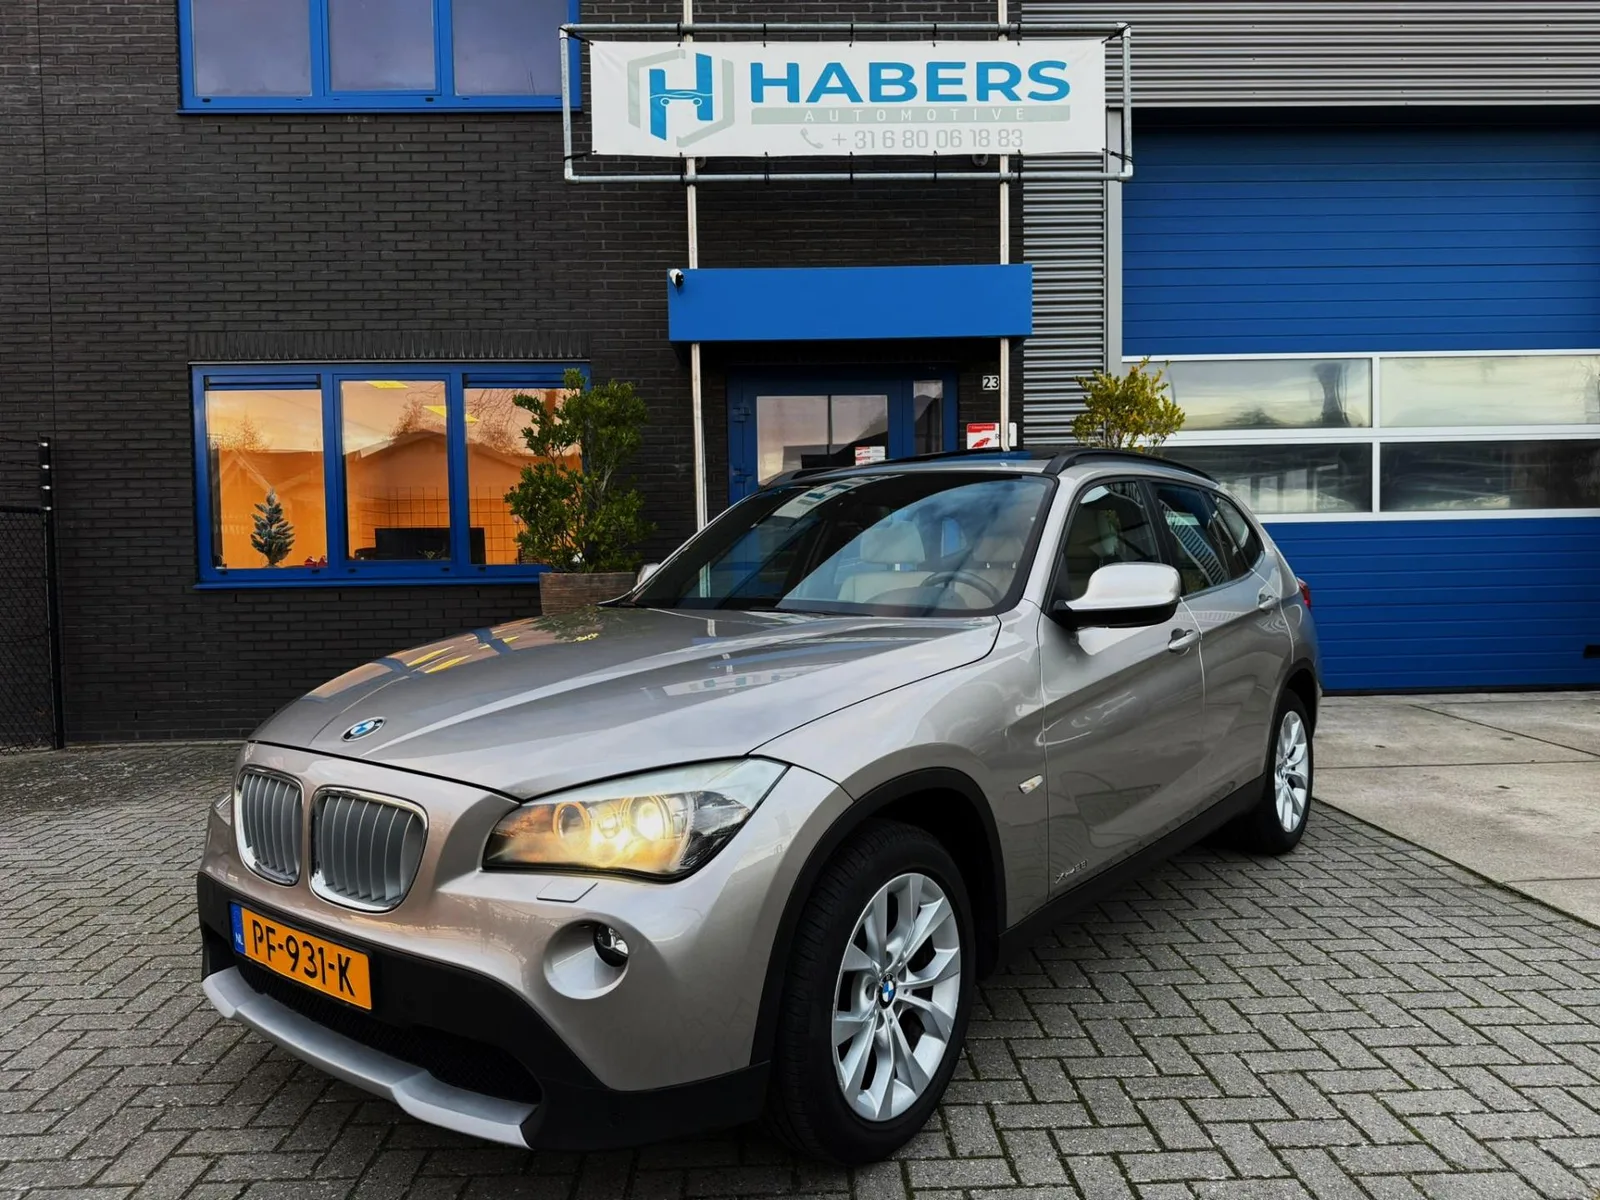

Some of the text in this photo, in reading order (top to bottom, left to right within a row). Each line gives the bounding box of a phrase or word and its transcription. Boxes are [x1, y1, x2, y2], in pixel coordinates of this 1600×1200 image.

[750, 60, 1071, 103] HABERS
[804, 108, 1025, 122] AUTOMOTIVE
[983, 376, 999, 389] 23
[252, 919, 356, 998] PF-931-K
